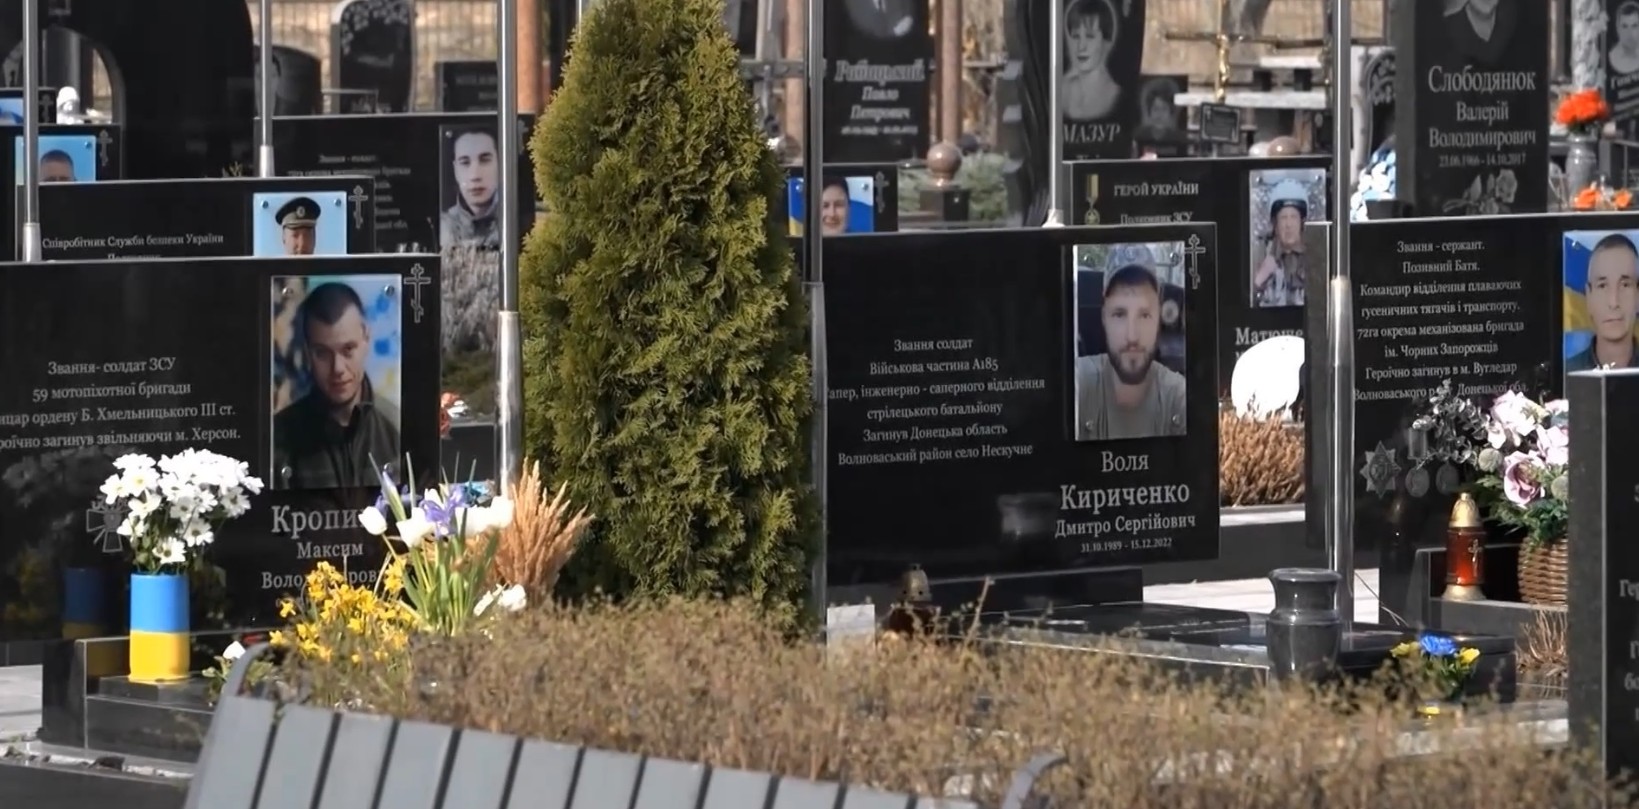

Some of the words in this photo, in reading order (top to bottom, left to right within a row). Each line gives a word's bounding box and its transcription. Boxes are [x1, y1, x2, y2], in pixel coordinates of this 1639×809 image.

[1428, 64, 1536, 94] Слободянюк
[1456, 100, 1509, 126] Валерій
[1429, 127, 1536, 151] Володимирович
[1113, 182, 1149, 197] ГЕРОЙ
[1151, 181, 1199, 196] УКРАЇНИ
[42, 236, 106, 250] Співробітник
[107, 234, 144, 247] Служби
[146, 234, 184, 246] безпеки
[185, 232, 224, 244] України
[1397, 241, 1434, 253] Звання
[1442, 241, 1485, 254] сержант.
[1402, 260, 1452, 274] Позивний
[1455, 260, 1480, 272] Батя.
[1360, 284, 1411, 298] Командир
[1413, 280, 1466, 295] відділення
[1468, 281, 1522, 293] плаваючих
[1361, 306, 1418, 320] гусеничних
[1420, 301, 1456, 315] тягачів
[1457, 301, 1462, 313] і
[1463, 301, 1520, 315] транспорту.
[1357, 327, 1379, 340] 72га
[1381, 326, 1417, 339] окрема
[1419, 322, 1483, 336] механізована
[1485, 320, 1525, 334] бригада
[894, 339, 934, 353] Звання
[936, 339, 973, 351] солдат
[1385, 345, 1399, 358] ім.
[1400, 345, 1439, 359] Чорних
[1440, 341, 1499, 357] Запорожців
[48, 360, 100, 375] Звання-
[103, 360, 147, 373] солдат
[150, 356, 176, 371] ЗСУ
[870, 361, 924, 376] Військова
[926, 360, 970, 373] частина
[1365, 366, 1410, 382] Героїчно
[1412, 364, 1451, 379] загинув
[1460, 365, 1471, 375] м.
[1473, 361, 1517, 377] Вугледар
[33, 388, 48, 403] 59
[51, 382, 136, 400] мотопіхотної
[138, 382, 191, 399] бригади
[827, 387, 859, 402] апер,
[861, 384, 920, 401] інженерно
[929, 382, 985, 398] саперного
[987, 377, 1045, 393] відділення
[32, 410, 78, 427] ордену
[81, 408, 94, 422] Б.
[96, 405, 198, 422] Хмельницького
[219, 403, 236, 416] ст.
[867, 404, 938, 422] стрілецького
[940, 401, 1003, 417] батальйону
[42, 433, 94, 450] загинув
[97, 429, 172, 446] звільняючи
[175, 429, 189, 442] м.
[192, 426, 241, 443] Херсон.
[863, 428, 908, 443] Загинув
[910, 426, 963, 441] Донецька
[965, 422, 1008, 437] область
[838, 448, 917, 466] Волноваський
[919, 447, 951, 464] район
[954, 446, 980, 459] село
[981, 443, 1033, 460] Нескучне
[1101, 450, 1150, 473] Воля
[1060, 483, 1190, 515] Кириченко
[271, 504, 362, 540] Кропи
[1054, 518, 1111, 539] Дмитро
[1115, 513, 1196, 535] Сергійович
[296, 541, 364, 559] Максим
[1080, 540, 1123, 553] 31.10.1989
[1130, 537, 1172, 550] 15.12.2022
